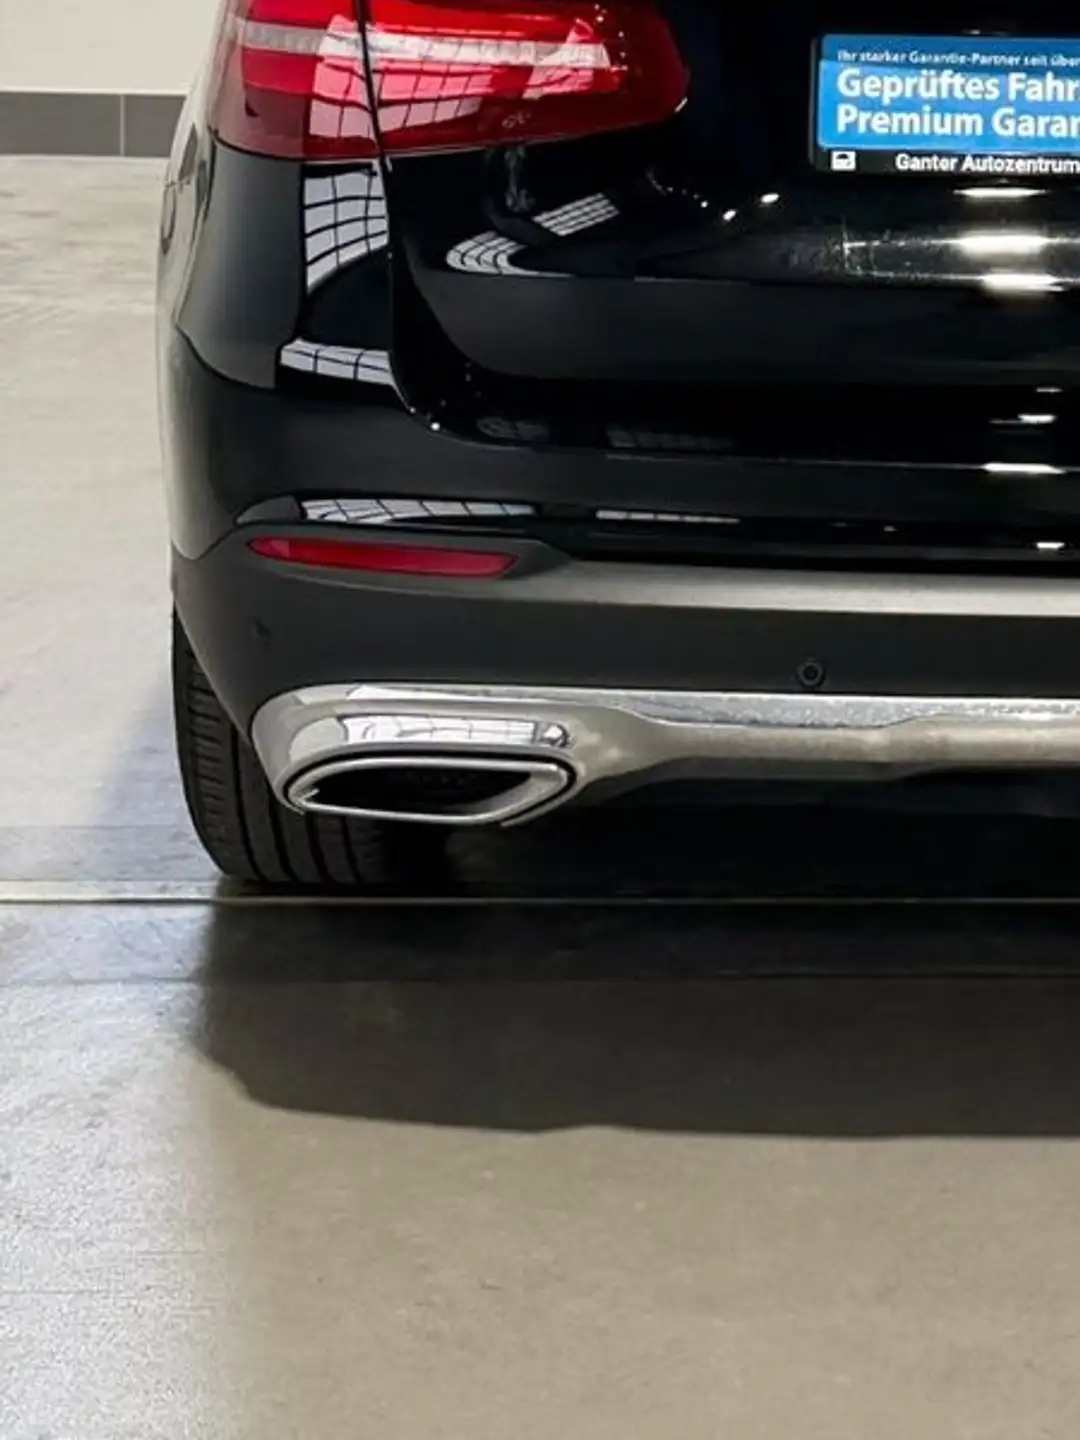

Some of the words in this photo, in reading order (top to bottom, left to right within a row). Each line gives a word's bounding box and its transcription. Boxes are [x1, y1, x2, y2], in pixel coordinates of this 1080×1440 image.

[837, 67, 1000, 106] Geprüftes
[837, 103, 983, 136] Premium
[895, 153, 957, 173] Ganter
[961, 154, 1080, 175] Autozentrum
